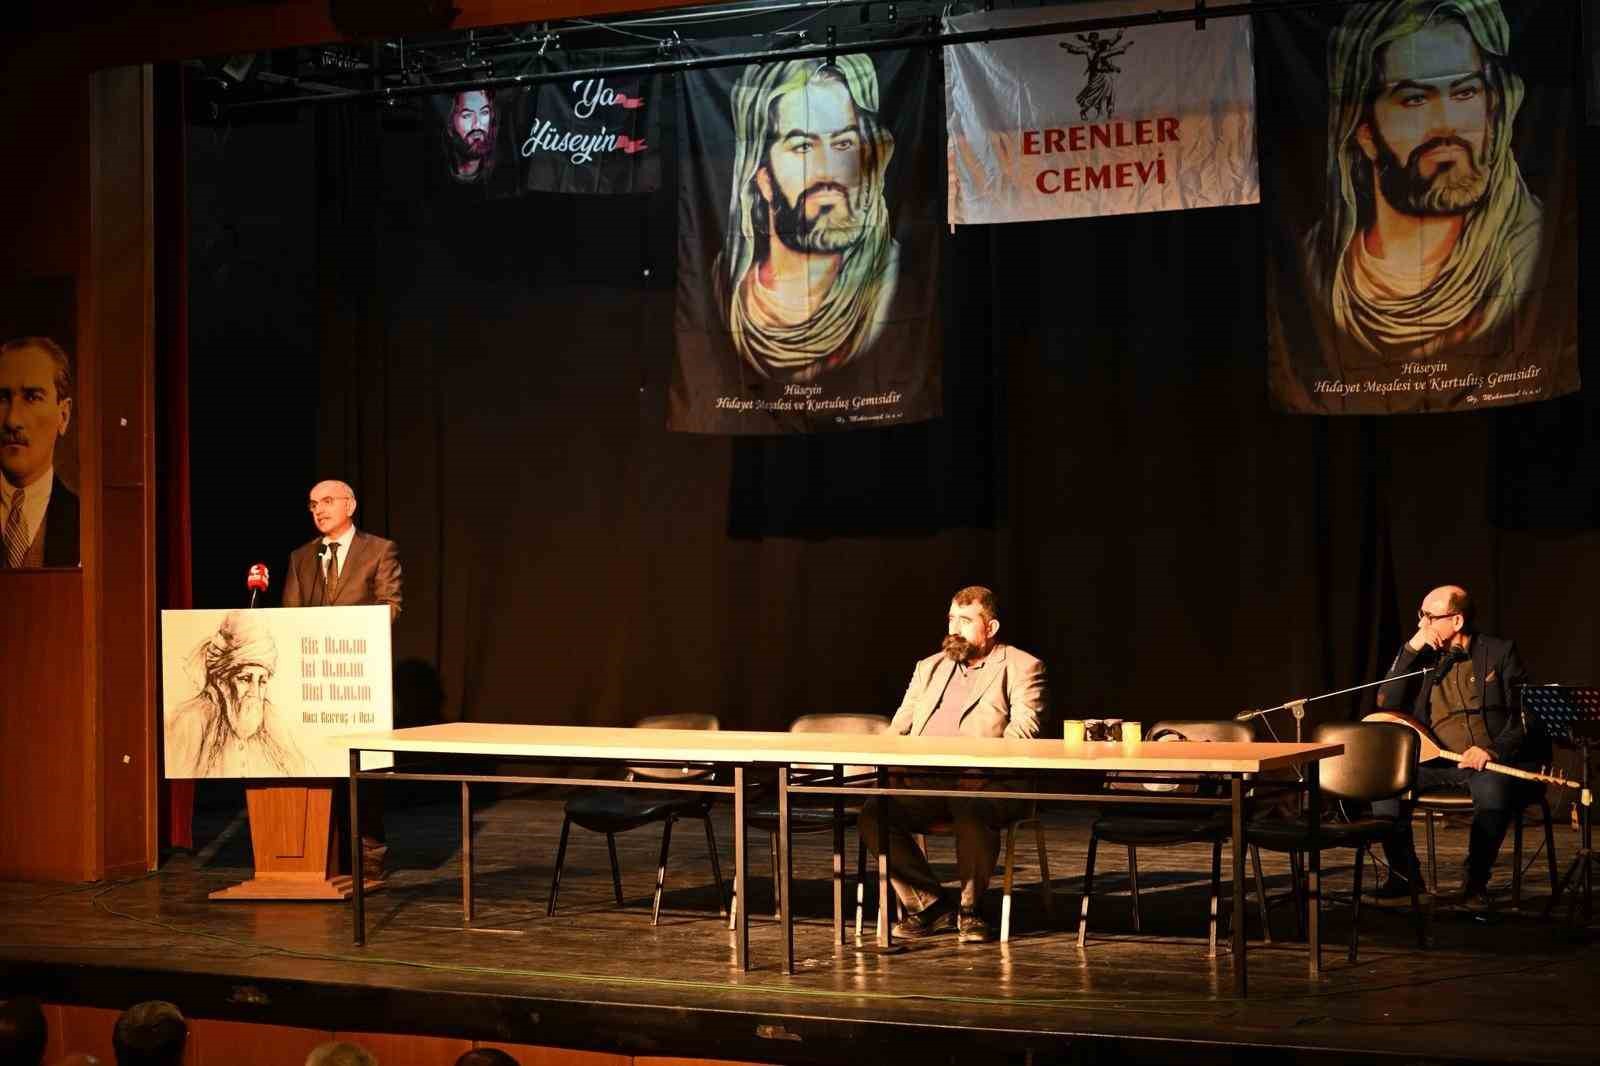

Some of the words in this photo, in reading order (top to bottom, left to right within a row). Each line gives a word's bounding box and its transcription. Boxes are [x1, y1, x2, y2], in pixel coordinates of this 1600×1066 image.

[572, 78, 617, 118] Ya
[521, 118, 618, 165] Hüseyin
[1023, 117, 1180, 155] ERENLER
[1036, 152, 1166, 194] CEMEVİ
[1363, 378, 1411, 396] Meşalesi
[1414, 380, 1427, 391] ve
[1429, 372, 1484, 392] Kurtuluş
[1402, 361, 1448, 377] Hüseyin
